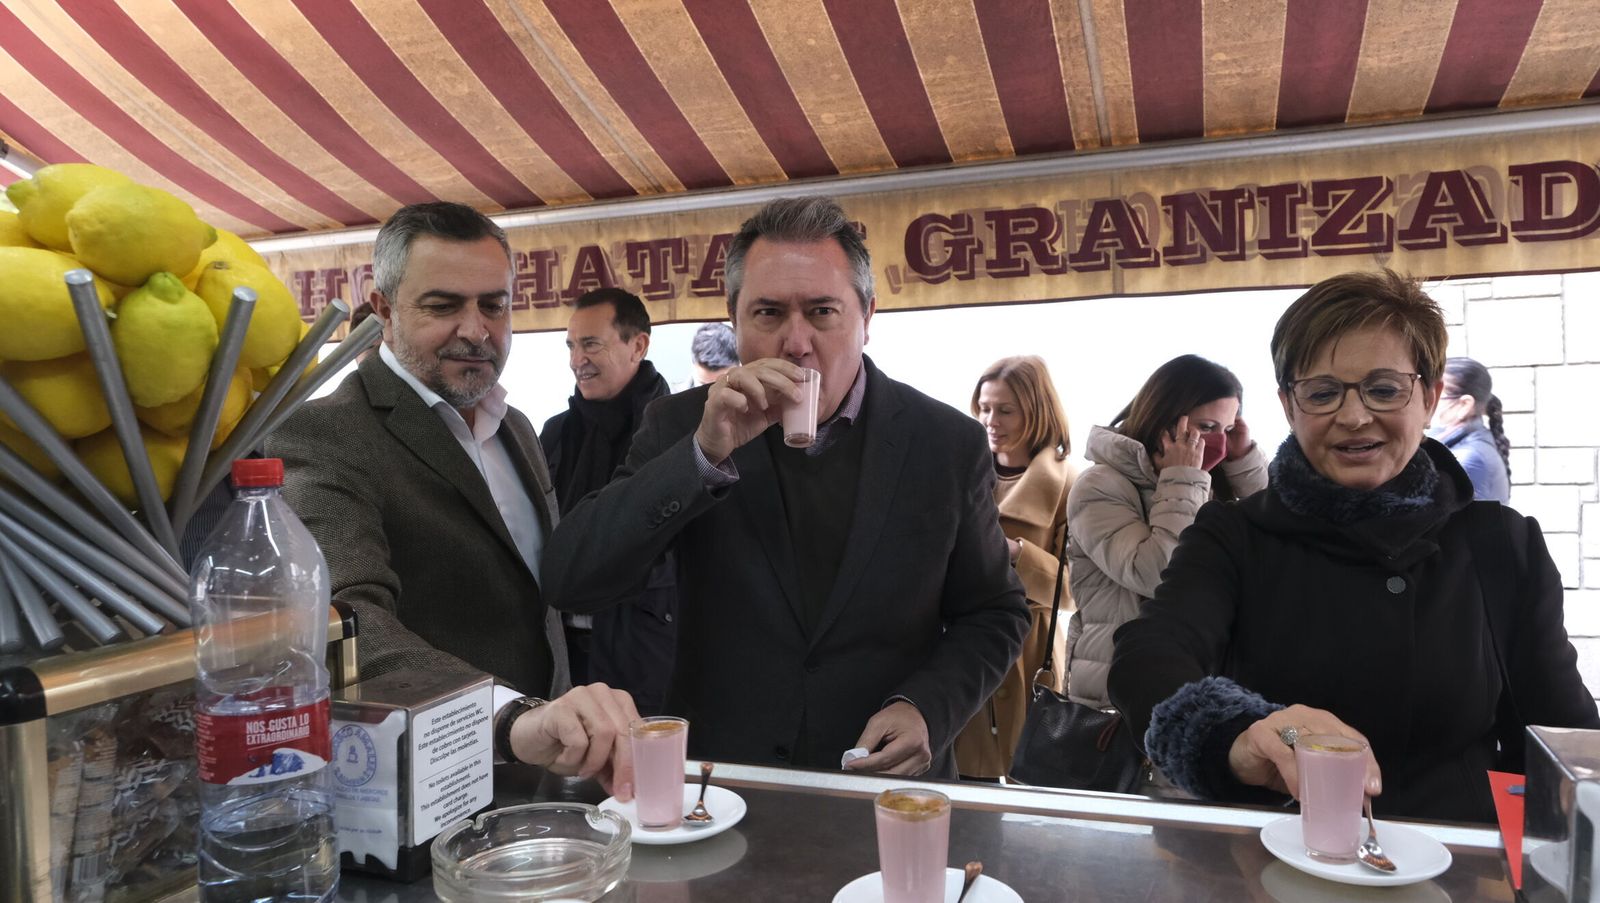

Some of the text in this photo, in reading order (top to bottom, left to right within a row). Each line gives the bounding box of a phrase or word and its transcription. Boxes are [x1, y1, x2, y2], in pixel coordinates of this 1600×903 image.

[246, 712, 310, 734] NOS GUSTA LO
[431, 702, 477, 726] Este establecimiento
[431, 723, 449, 735] dispone
[456, 712, 475, 724] servicios
[475, 707, 484, 715] WC
[246, 725, 310, 746] EXTRAORDINARIO
[418, 743, 428, 751] Este
[429, 726, 465, 746] establecimiento
[472, 715, 489, 727] dispone
[439, 740, 453, 751] cobro
[430, 752, 450, 765] Disculpe
[450, 765, 469, 778] available
[474, 759, 482, 767] this
[421, 772, 488, 812] This establishment does not have
[469, 796, 477, 804] any
[443, 799, 453, 809] card
